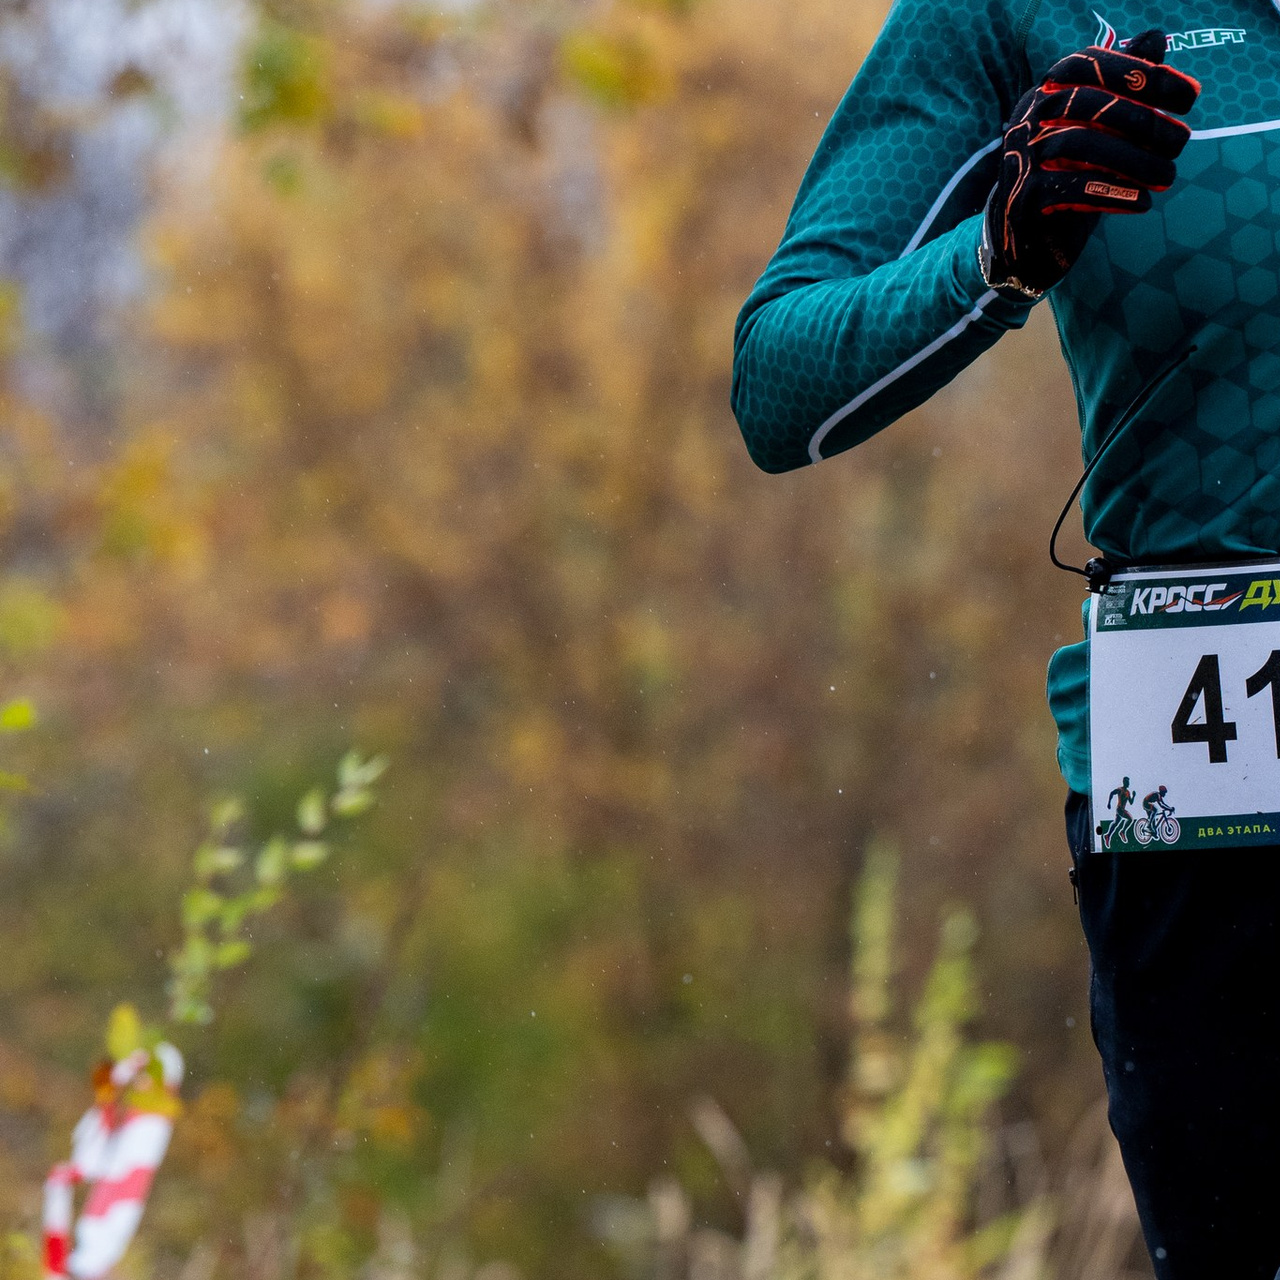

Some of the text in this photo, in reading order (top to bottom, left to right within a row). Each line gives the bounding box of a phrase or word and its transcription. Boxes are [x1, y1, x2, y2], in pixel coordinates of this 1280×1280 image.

[1130, 583, 1231, 616] КРОСС
[1198, 827, 1224, 838] ДВА
[1227, 824, 1276, 835] ЭТАПА.
